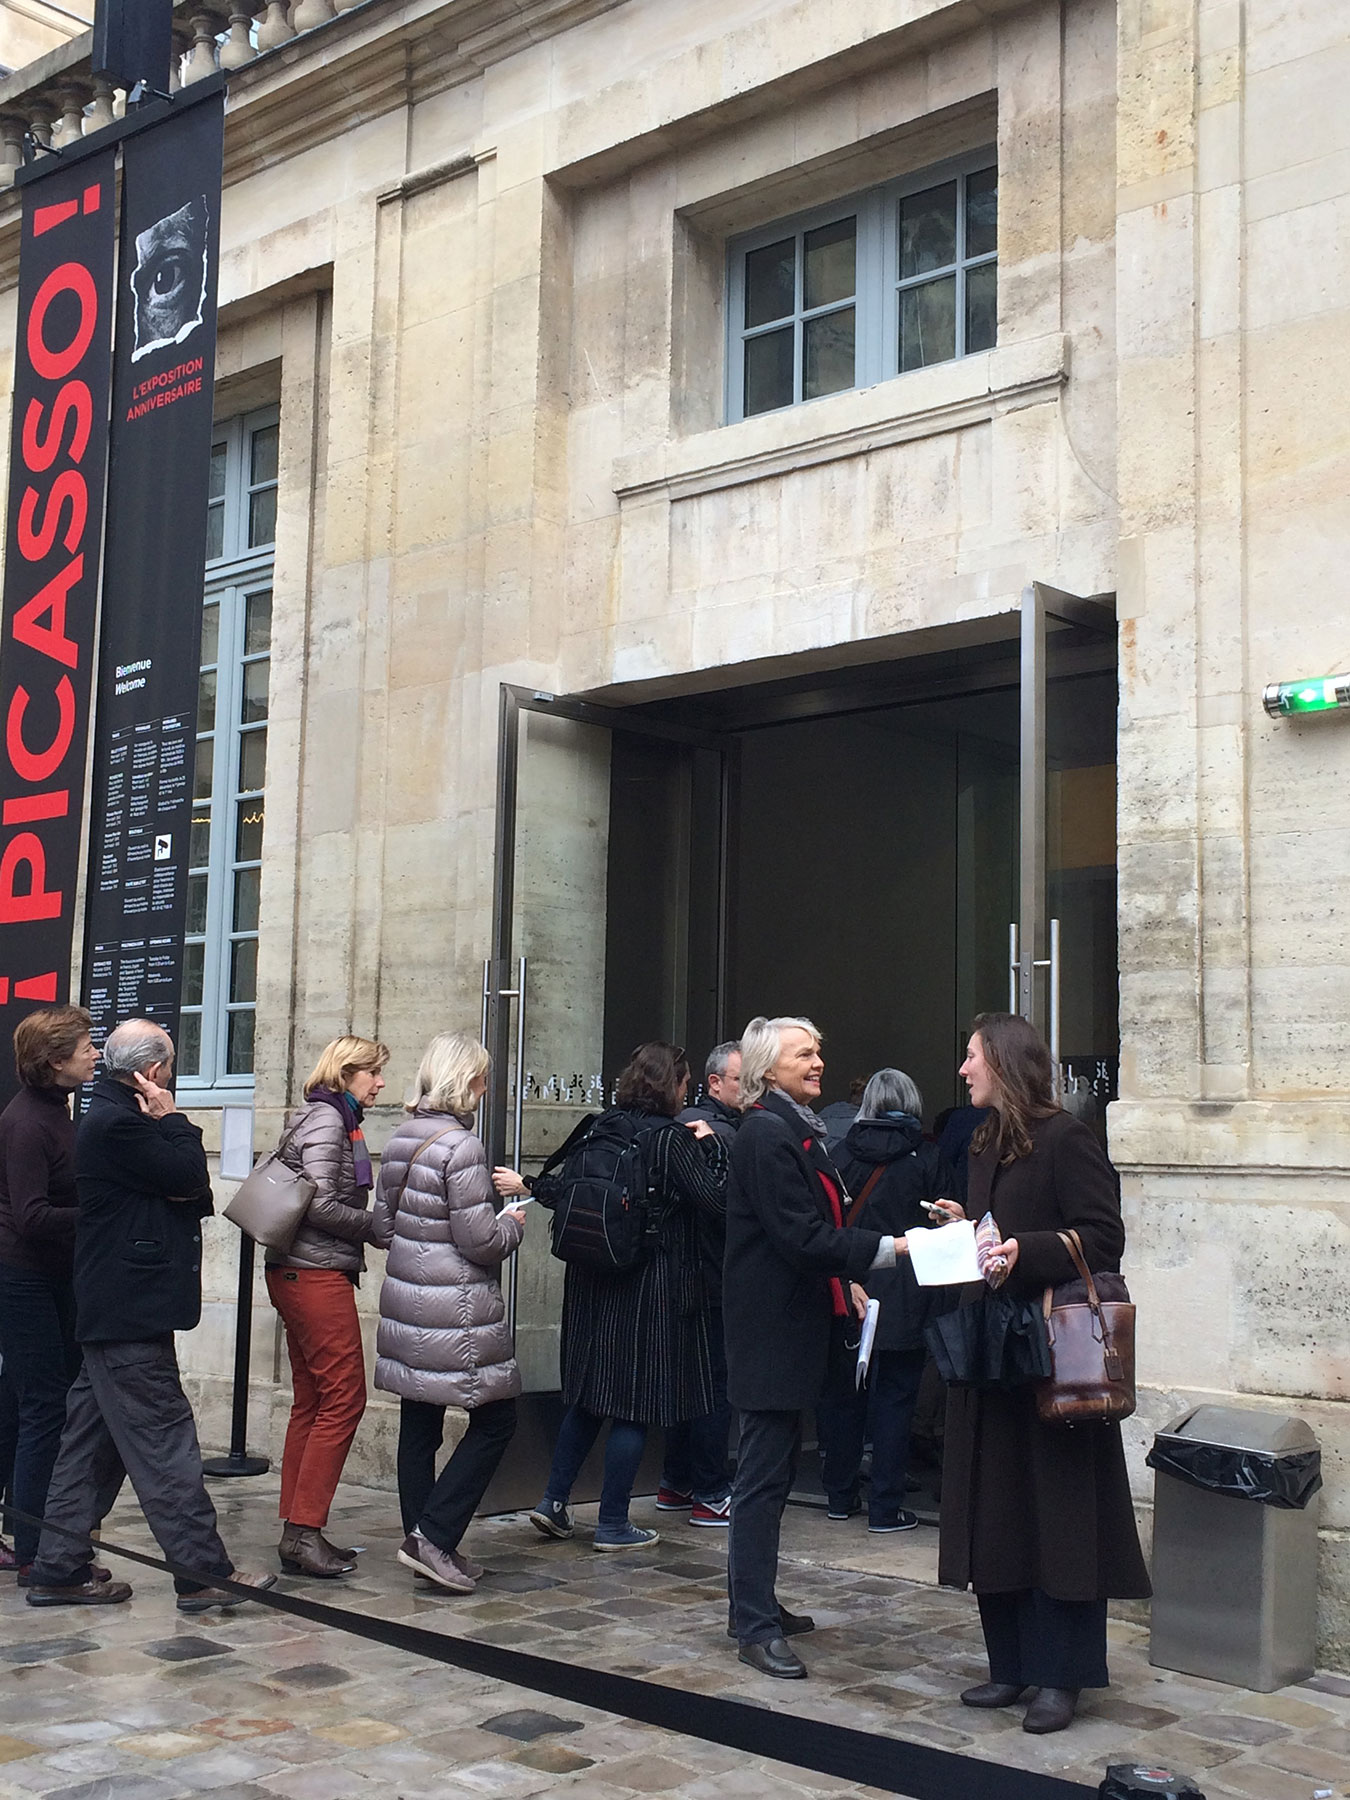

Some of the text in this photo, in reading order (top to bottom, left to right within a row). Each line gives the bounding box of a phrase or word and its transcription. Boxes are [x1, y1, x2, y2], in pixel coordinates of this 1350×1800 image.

[126, 377, 202, 422] ANNIVERSAIRE
[132, 356, 204, 401] L'EXPOSITION
[0, 263, 98, 924] PICASSO
[114, 676, 146, 696] Welcome
[115, 657, 152, 679] Bienvenue
